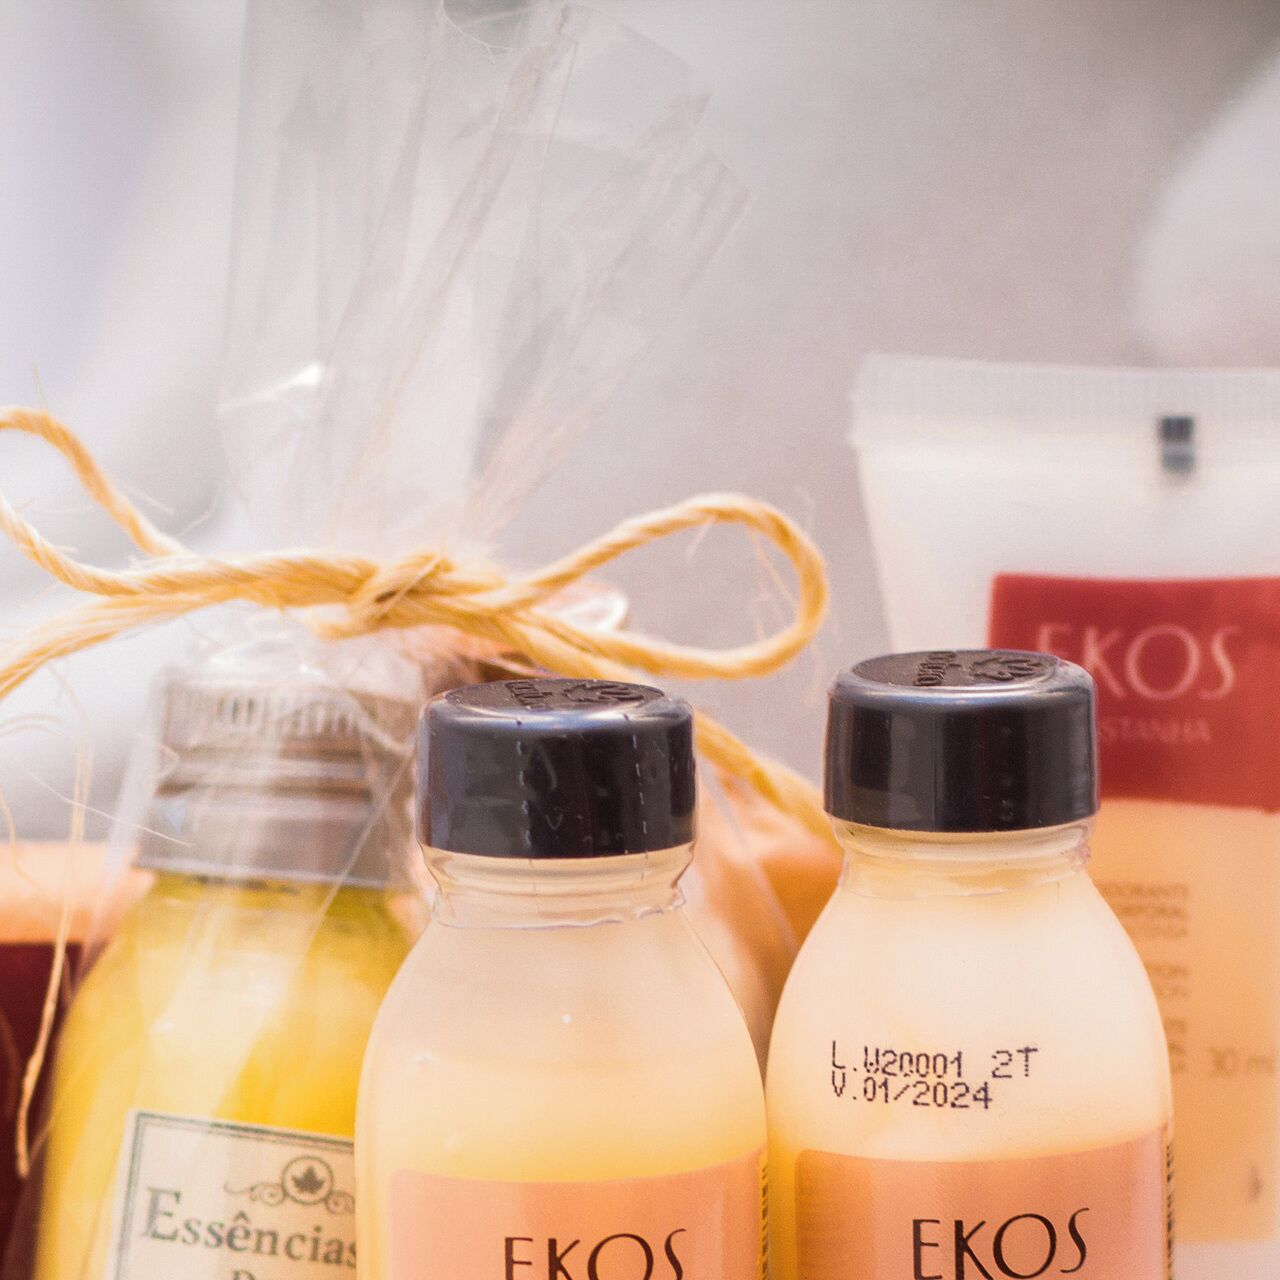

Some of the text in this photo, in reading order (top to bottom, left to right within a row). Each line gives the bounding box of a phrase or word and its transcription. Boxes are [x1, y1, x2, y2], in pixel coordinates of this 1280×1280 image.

[990, 1046, 1039, 1079] 2T
[831, 1069, 994, 1110] V.01/2024
[141, 1187, 357, 1269] Essências
